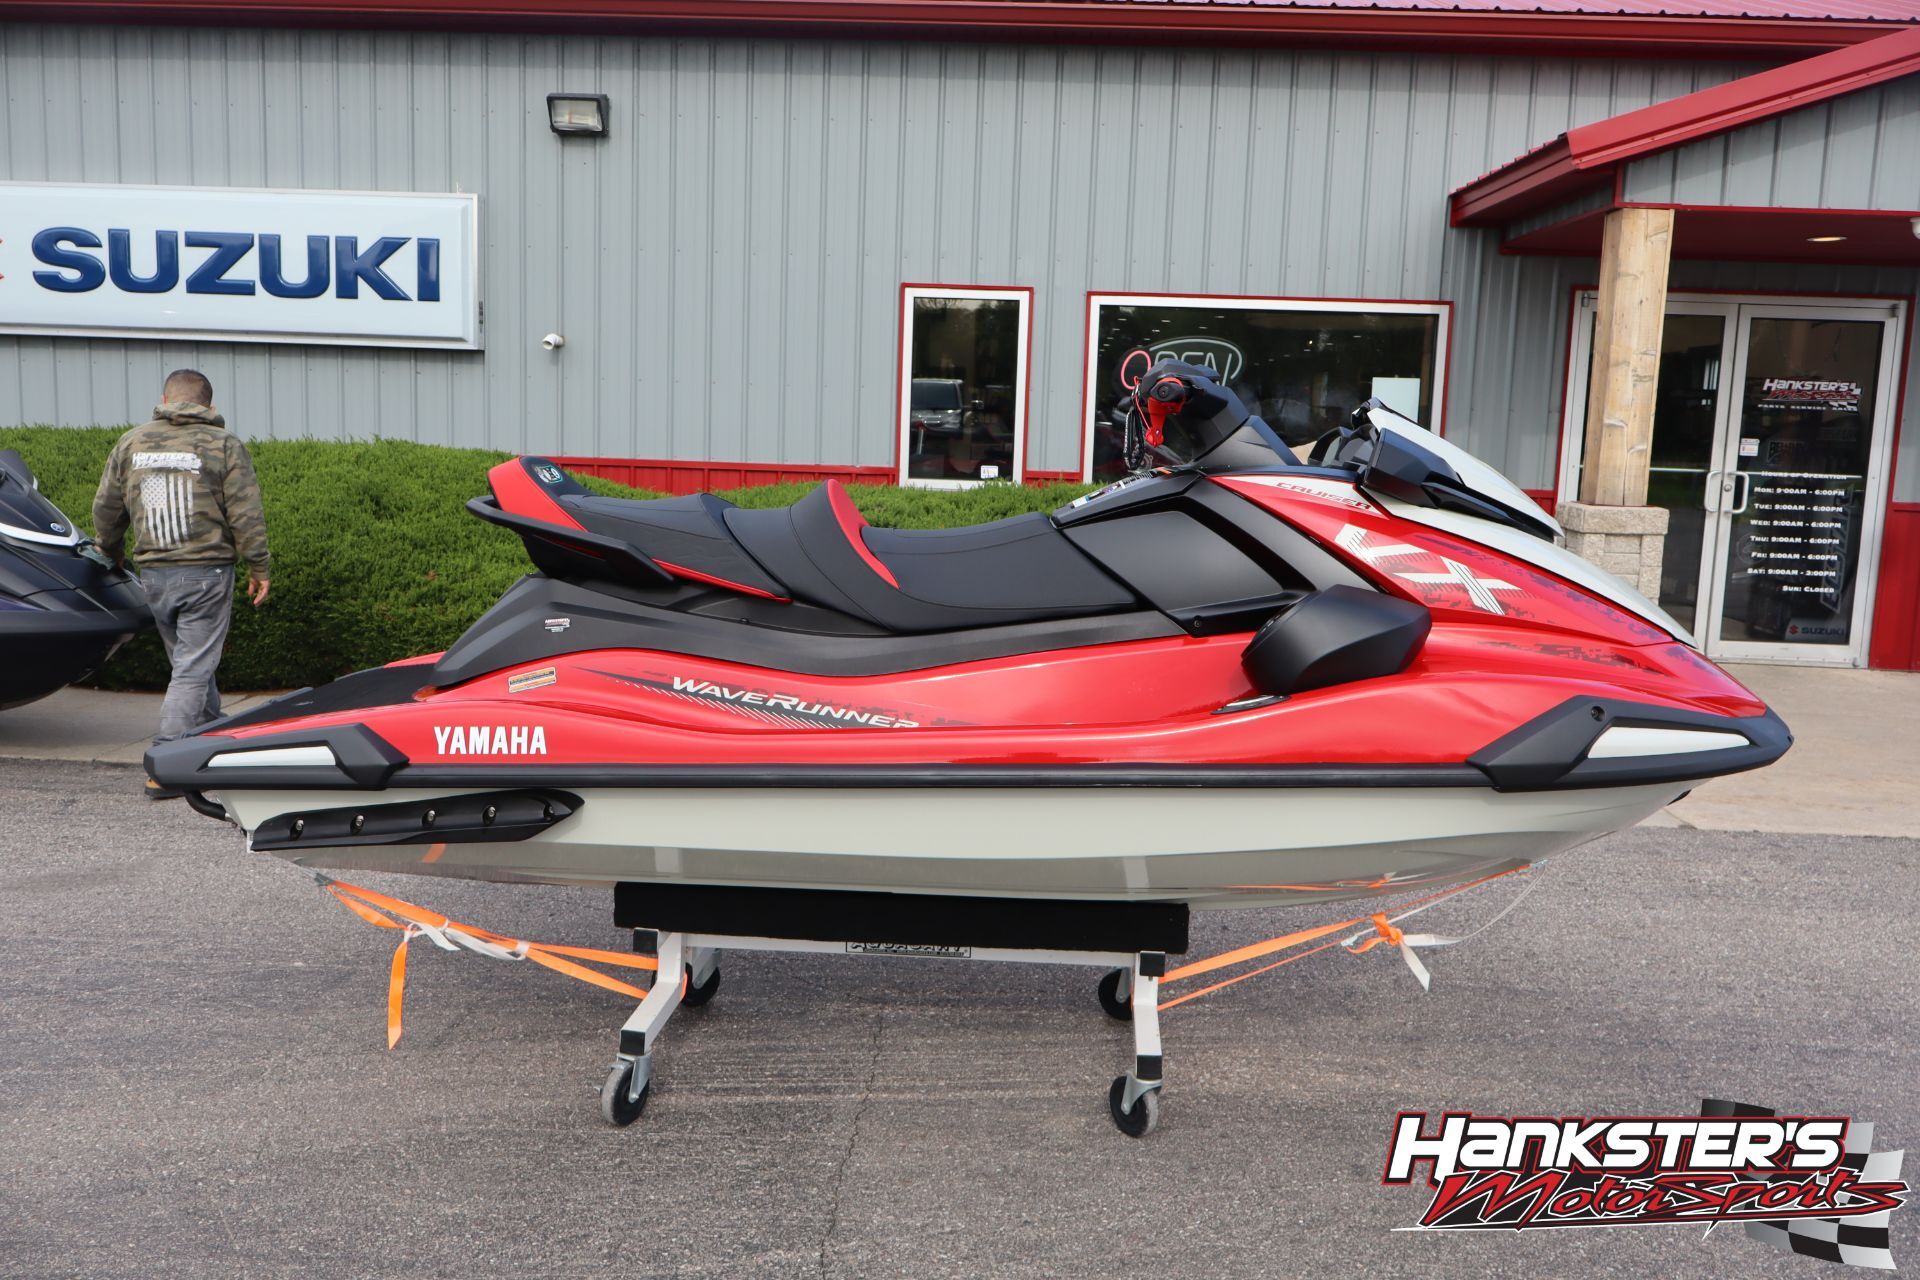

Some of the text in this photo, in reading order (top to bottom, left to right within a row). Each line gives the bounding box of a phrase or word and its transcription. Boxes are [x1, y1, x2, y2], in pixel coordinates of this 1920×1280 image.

[32, 226, 441, 302] SUZUKI
[1276, 482, 1371, 510] CRUISER
[1814, 489, 1845, 497] 6:00PM
[1812, 505, 1843, 513] 6:00PM
[1773, 520, 1804, 528] 9:00AM
[1811, 521, 1842, 529] 6:00PM
[1771, 536, 1802, 544] 9:00AM
[1809, 537, 1840, 545] 6:00PM
[1769, 552, 1800, 560] 9:00AM
[1807, 553, 1838, 561] 6:00PM
[1768, 568, 1799, 576] 9:00AM
[433, 725, 548, 755] YAMAHA
